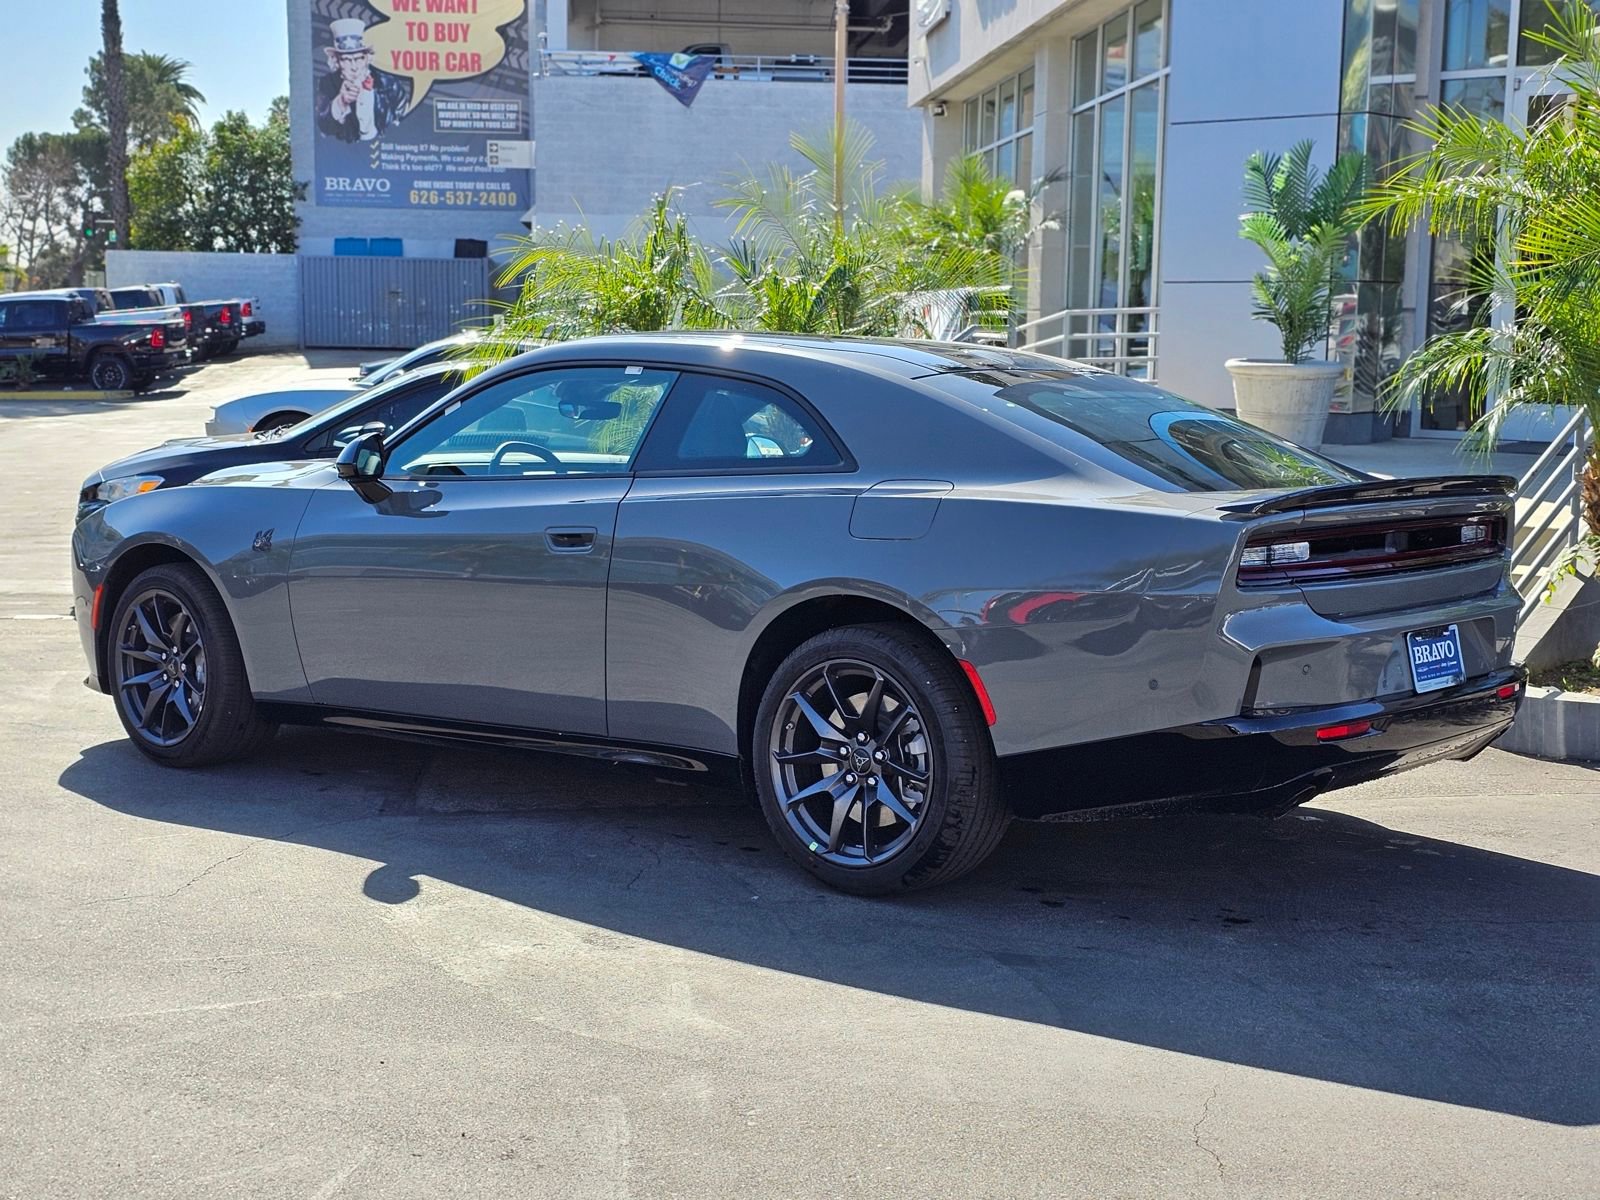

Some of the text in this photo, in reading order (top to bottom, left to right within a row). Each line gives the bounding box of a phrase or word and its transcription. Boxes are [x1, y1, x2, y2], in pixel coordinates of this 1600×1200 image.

[405, 21, 470, 43] TO BUY
[391, 50, 482, 72] YOUR CAR
[440, 120, 451, 128] TOP
[430, 144, 439, 152] No
[381, 153, 405, 162] Making
[441, 154, 451, 162] We
[465, 155, 477, 164] pay
[381, 162, 400, 170] Think
[324, 177, 391, 192] BRAVO
[413, 180, 432, 189] COME
[455, 181, 475, 190] TODAY
[485, 182, 501, 190] CALL
[409, 189, 517, 206] 626-537-2400
[1412, 640, 1455, 665] BRAVO
